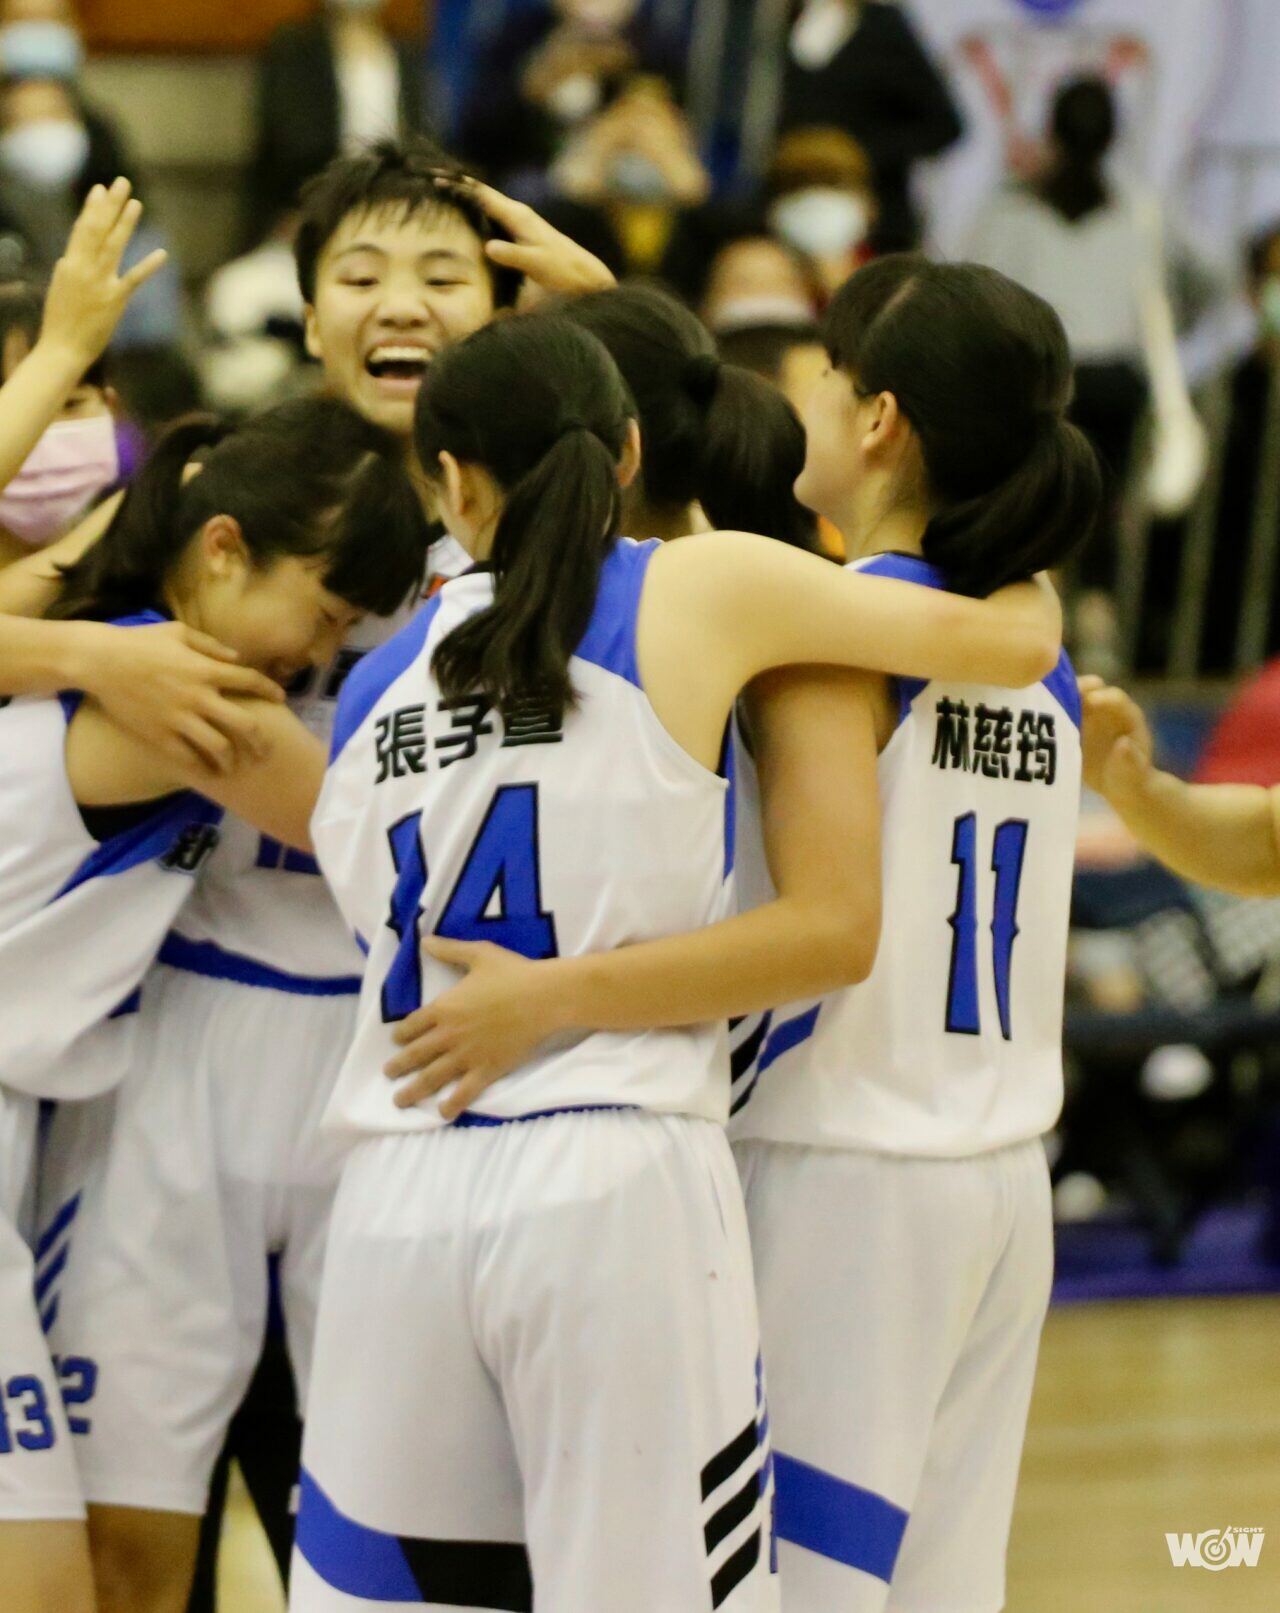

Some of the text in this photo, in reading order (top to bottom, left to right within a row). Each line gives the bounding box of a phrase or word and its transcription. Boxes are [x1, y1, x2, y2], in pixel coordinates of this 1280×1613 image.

[931, 695, 1057, 786] 林慈筠
[381, 782, 560, 1024] 14
[945, 810, 1030, 1041] 11
[51, 1354, 99, 1435] 2
